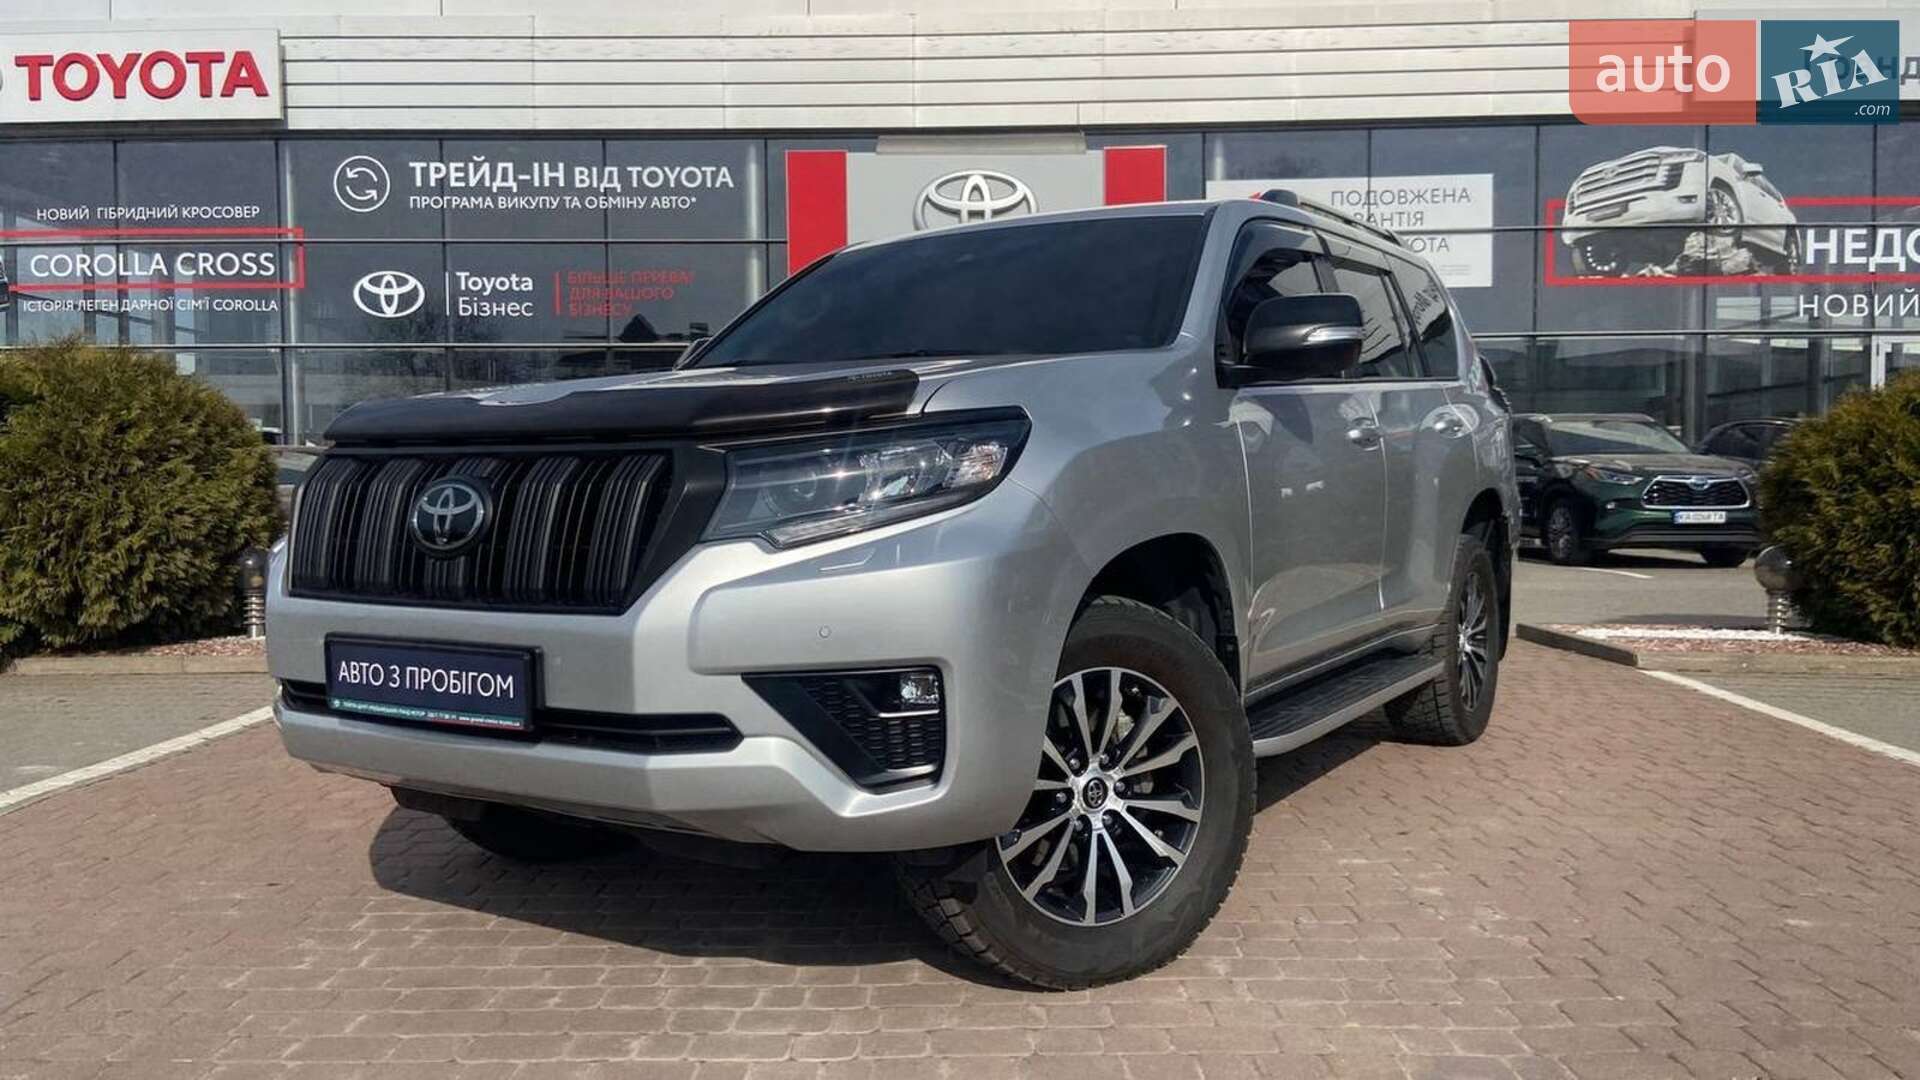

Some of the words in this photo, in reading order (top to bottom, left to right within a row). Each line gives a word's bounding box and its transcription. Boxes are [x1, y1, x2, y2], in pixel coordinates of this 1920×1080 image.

[15, 50, 270, 101] TOYOTA
[409, 155, 565, 192] ТРЕЙД-ІН
[574, 166, 621, 192] ВІД
[626, 166, 734, 188] TOYOTA
[410, 196, 494, 209] ПРОГРАМА
[498, 196, 560, 209] ВИКУПУ
[563, 196, 582, 208] ТА
[585, 196, 647, 209] ОБМІНУ
[1331, 188, 1472, 207] ПОДОВЖЕНА
[37, 206, 90, 221] НОВИЙ
[97, 205, 178, 220] ГІБРИДНИЙ
[182, 206, 260, 219] КРОСОВЕР
[30, 253, 168, 277] COROLLA
[176, 252, 276, 276] CROSS
[456, 271, 534, 296] Toyota
[23, 301, 74, 313] ІСТОРІЯ
[213, 301, 279, 312] COROLLA
[458, 297, 534, 317] Бізнес
[1799, 287, 1919, 317] НОВИЙ
[338, 660, 385, 687] АВТО
[405, 666, 514, 699] ПРОБІГОМ
